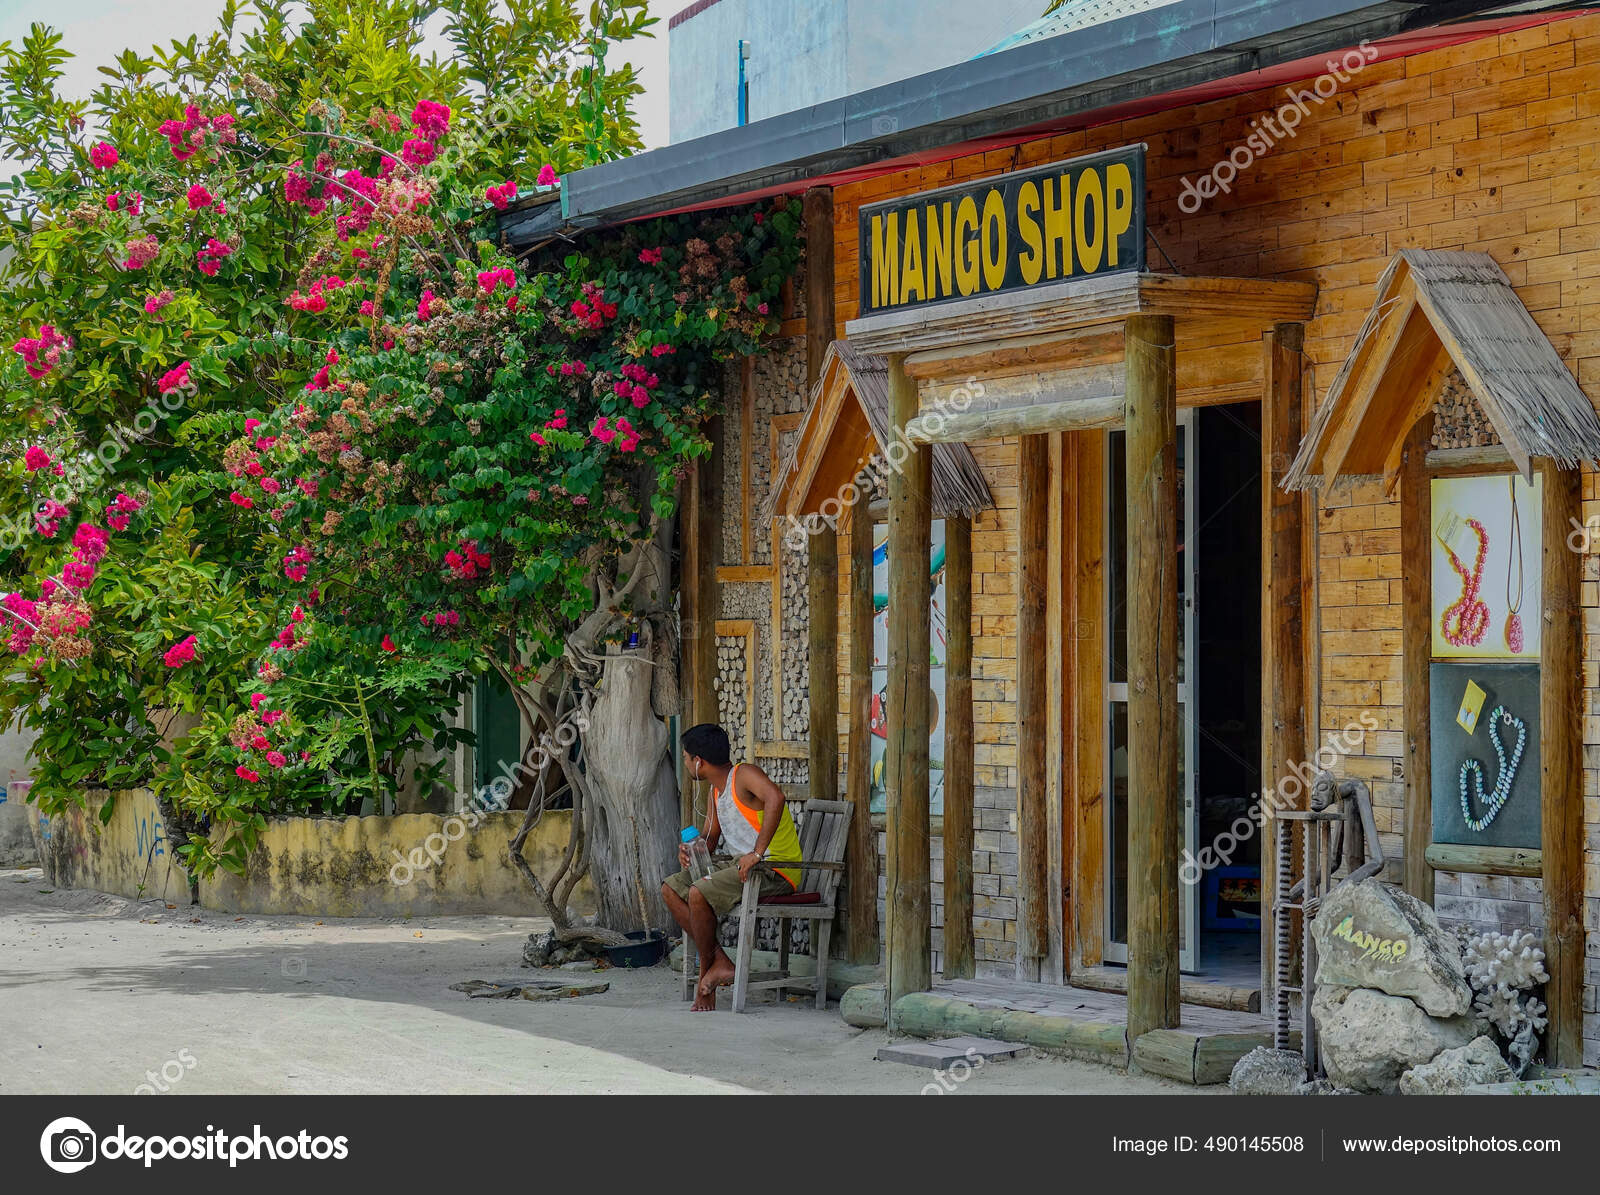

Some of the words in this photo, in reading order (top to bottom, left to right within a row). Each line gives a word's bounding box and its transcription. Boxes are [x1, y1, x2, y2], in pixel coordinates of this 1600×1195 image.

[871, 188, 1008, 309] MANGO
[1017, 162, 1133, 286] SHOP
[1332, 913, 1407, 955] MANGO
